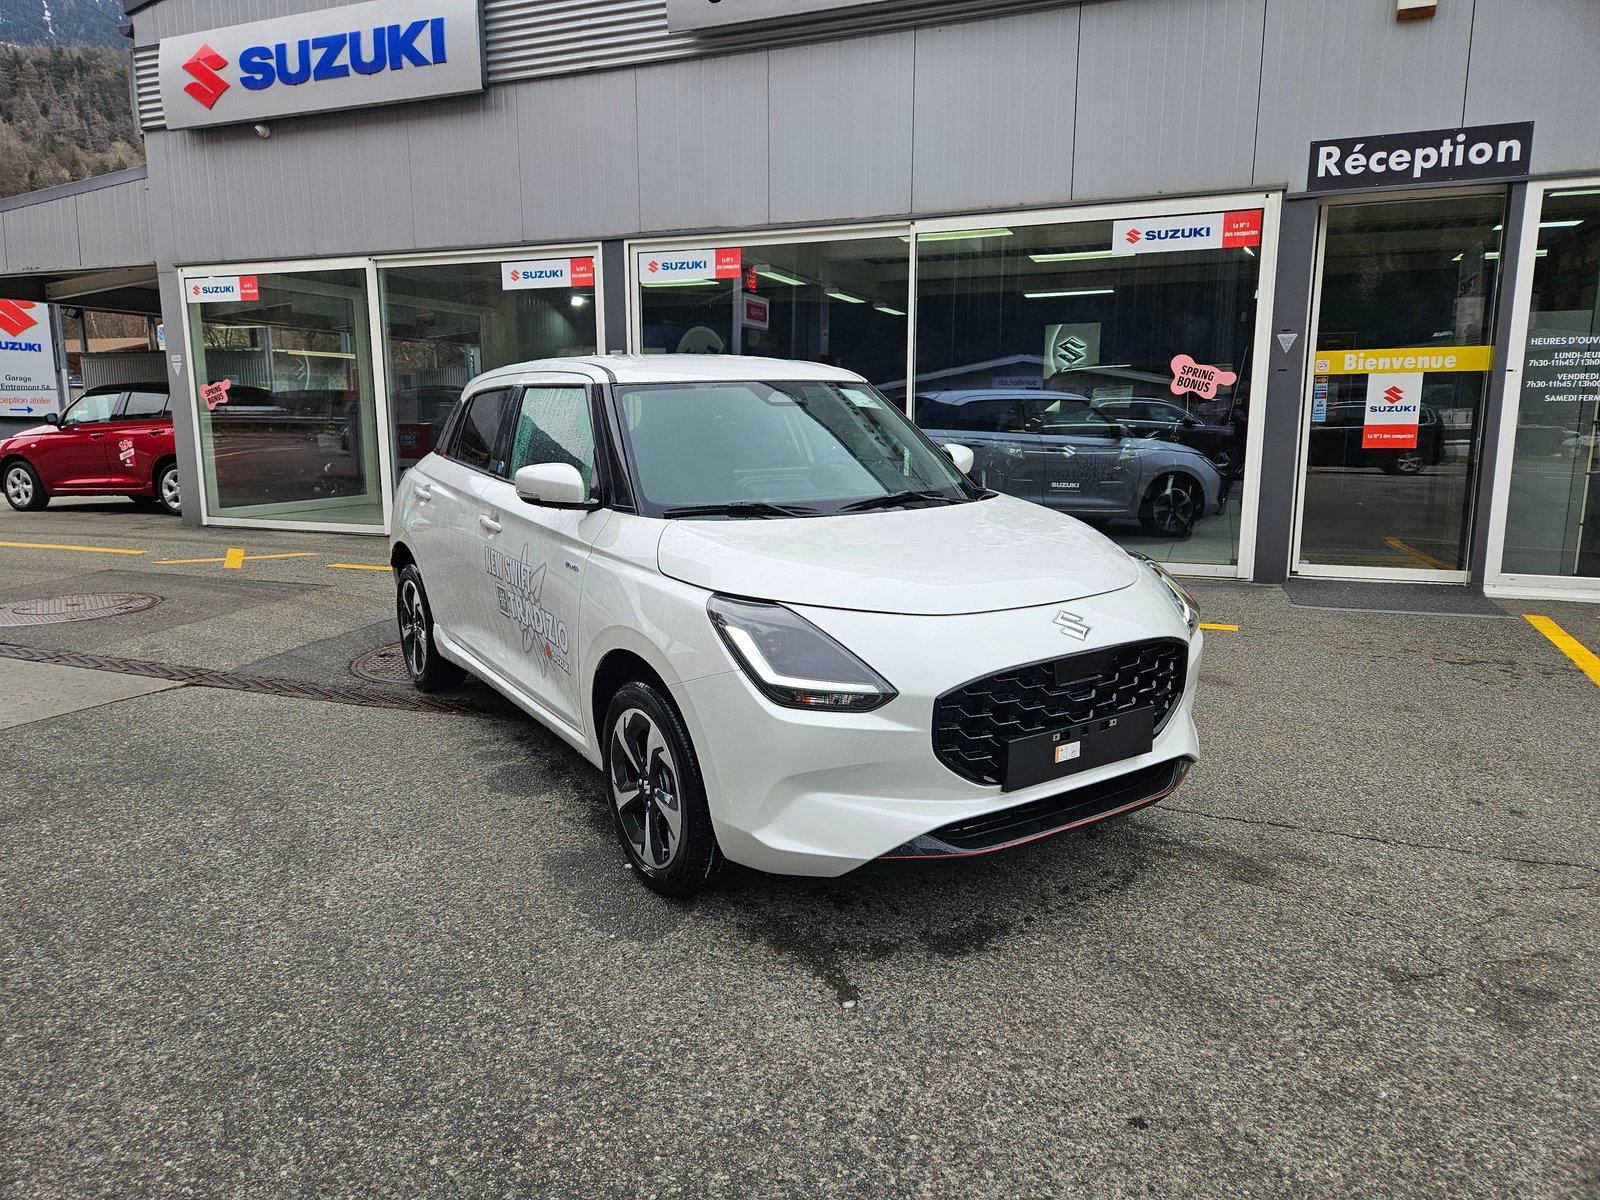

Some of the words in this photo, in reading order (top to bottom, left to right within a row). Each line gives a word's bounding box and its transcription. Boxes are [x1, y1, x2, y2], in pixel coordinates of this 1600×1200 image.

[239, 17, 447, 90] SUZUKI
[1317, 134, 1521, 178] Réception
[1145, 227, 1211, 240] SUZUKI
[661, 260, 707, 271] SUZUKI
[522, 269, 563, 280] SUZUKI
[202, 285, 234, 294] SUZUKI
[1531, 337, 1566, 345] HEURES
[1568, 336, 1600, 344] D'OUV
[1343, 352, 1457, 371] Bienvenue
[5, 374, 32, 383] Garage
[1181, 365, 1215, 381] SPRING
[205, 384, 222, 397] SPRING
[1177, 376, 1211, 392] BONUS
[207, 393, 224, 405] BONUS
[1369, 405, 1417, 413] SUZUKI
[485, 546, 504, 580] NEW
[504, 554, 532, 593] SWIFT
[506, 590, 569, 655] TRADIZIO
